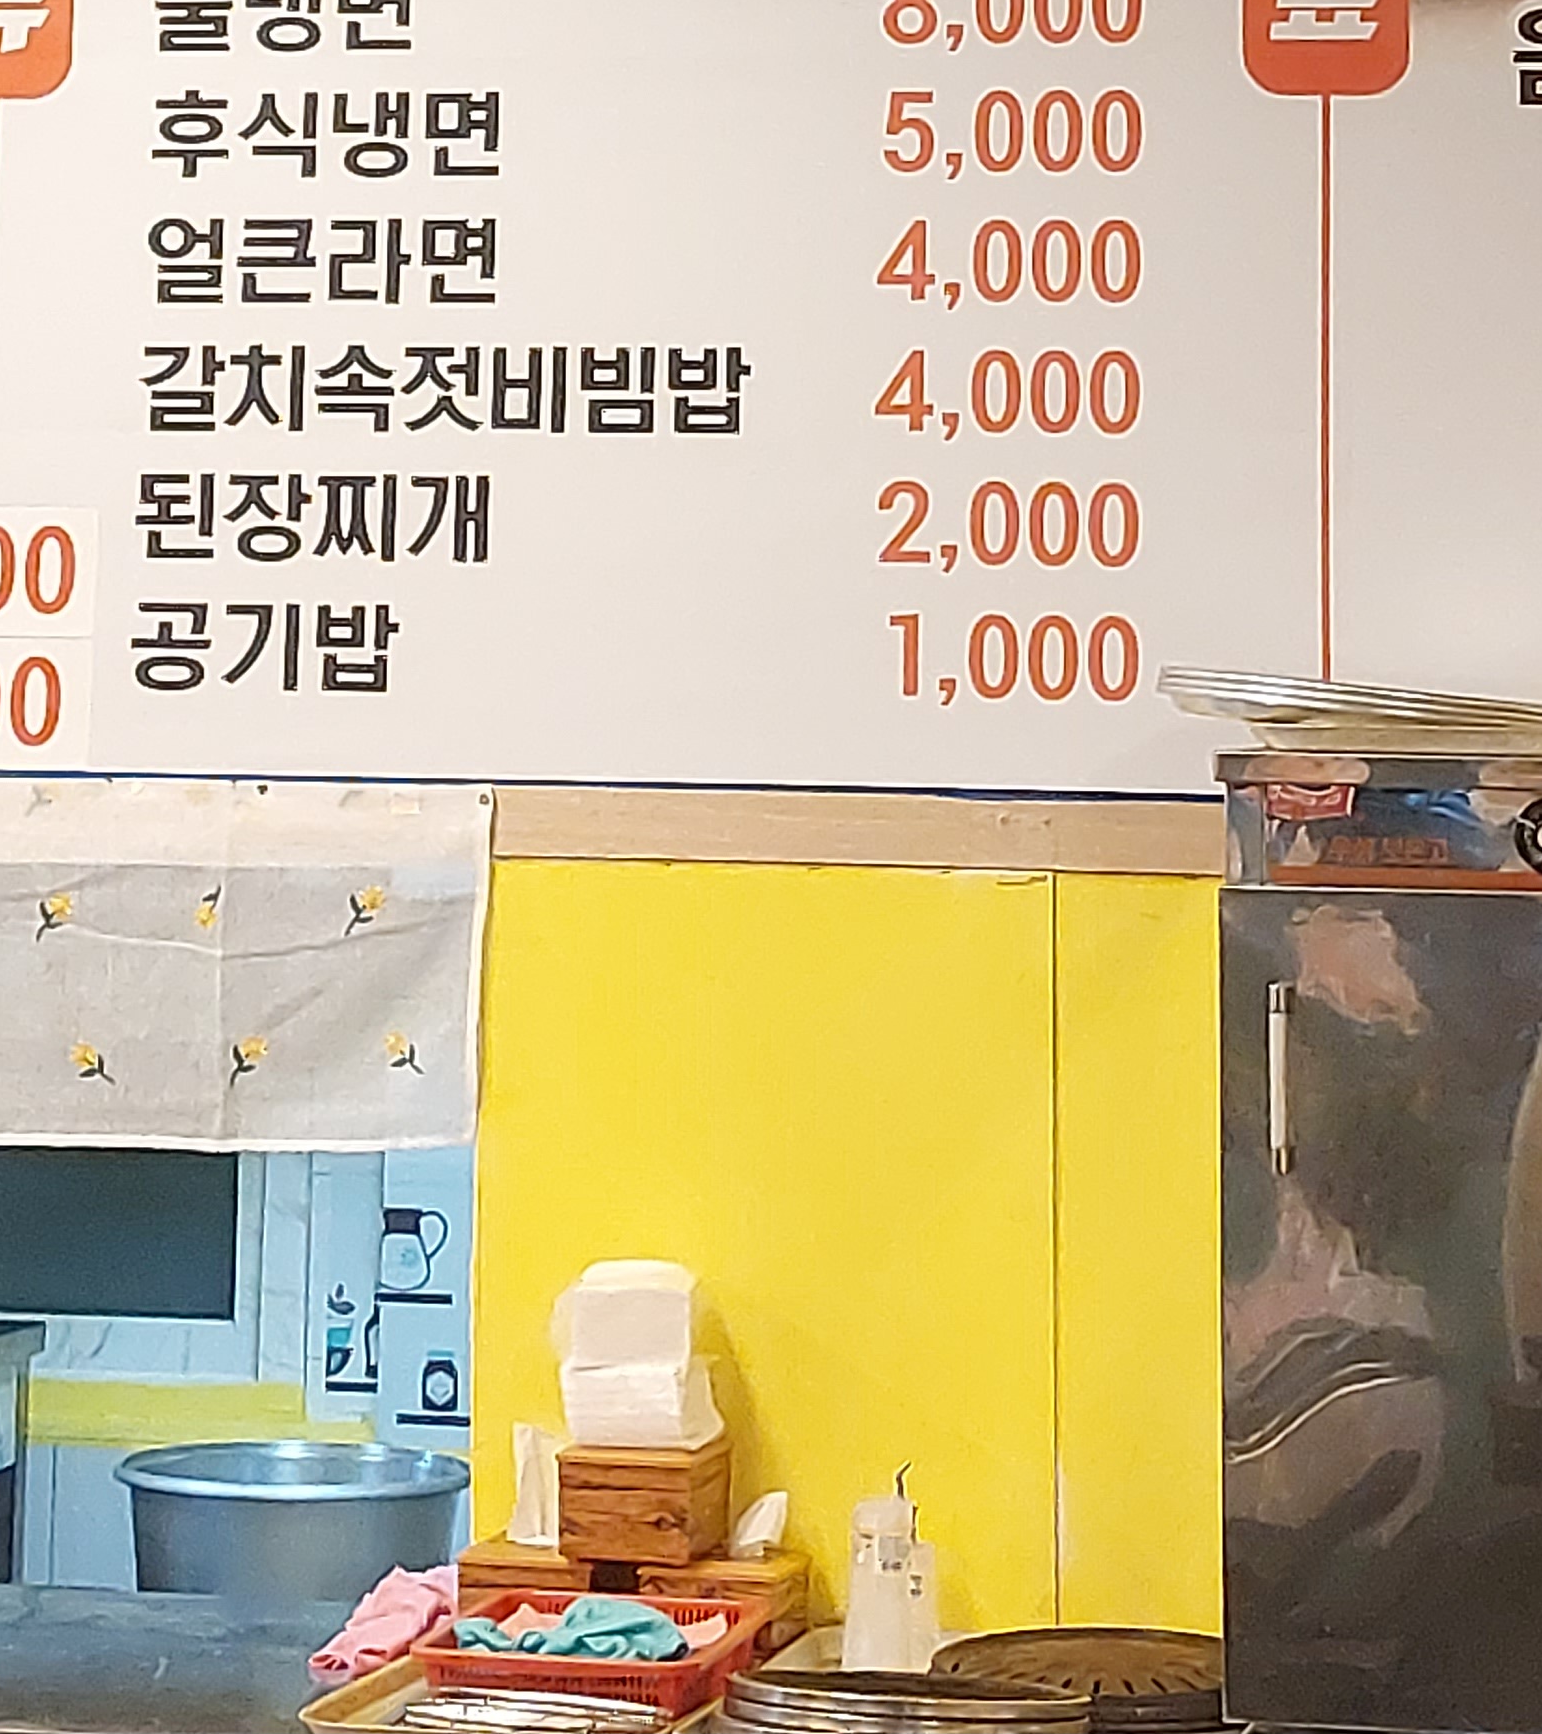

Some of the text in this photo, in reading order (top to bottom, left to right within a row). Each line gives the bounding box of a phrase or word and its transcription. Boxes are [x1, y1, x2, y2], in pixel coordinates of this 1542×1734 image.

[153, 90, 1141, 178] 후식냉면 5,000
[149, 219, 1141, 308] 얼큰라면 4,000
[143, 345, 1140, 439] 갈치속젓비빔밥 4,000
[136, 474, 1139, 571] 된장찌개 2,000
[132, 603, 1138, 705] 공기밥 1,000
